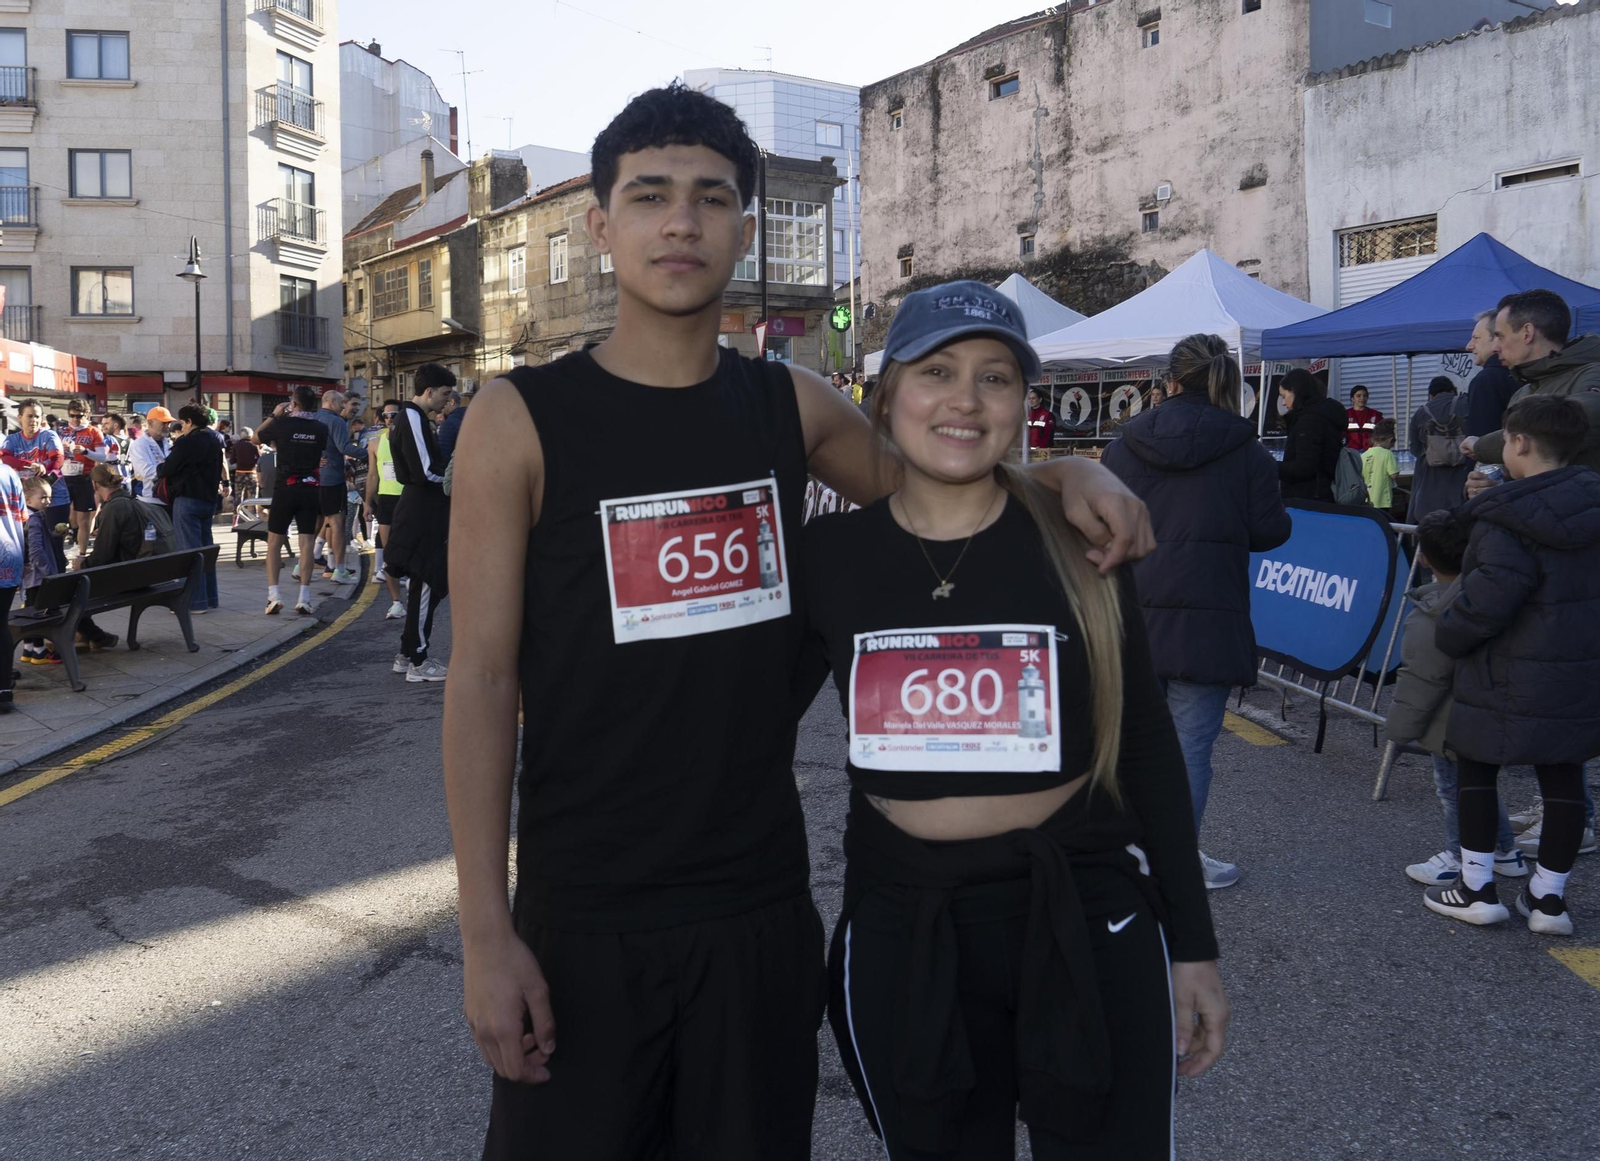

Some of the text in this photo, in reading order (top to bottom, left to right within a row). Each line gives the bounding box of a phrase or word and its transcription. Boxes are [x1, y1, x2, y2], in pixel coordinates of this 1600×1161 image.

[964, 308, 992, 320] 1861
[1055, 371, 1098, 382] FRUTASNIEVES
[1104, 369, 1151, 380] FRUTASNIEVES
[756, 504, 769, 519] 5K
[658, 528, 749, 584] 656
[671, 578, 743, 597] Angel Gabriel GOMEZ
[1255, 559, 1358, 612] DECATHLON
[650, 609, 686, 622] Santander
[917, 652, 963, 660] CARREIRA
[965, 652, 978, 660] DE
[1019, 649, 1041, 663] 5K
[900, 667, 1004, 716] 680
[913, 721, 926, 729] Del
[926, 721, 945, 729] Valle
[946, 721, 982, 731] VASQUEZ
[983, 721, 1021, 729] MORALES
[887, 742, 924, 751] Santander
